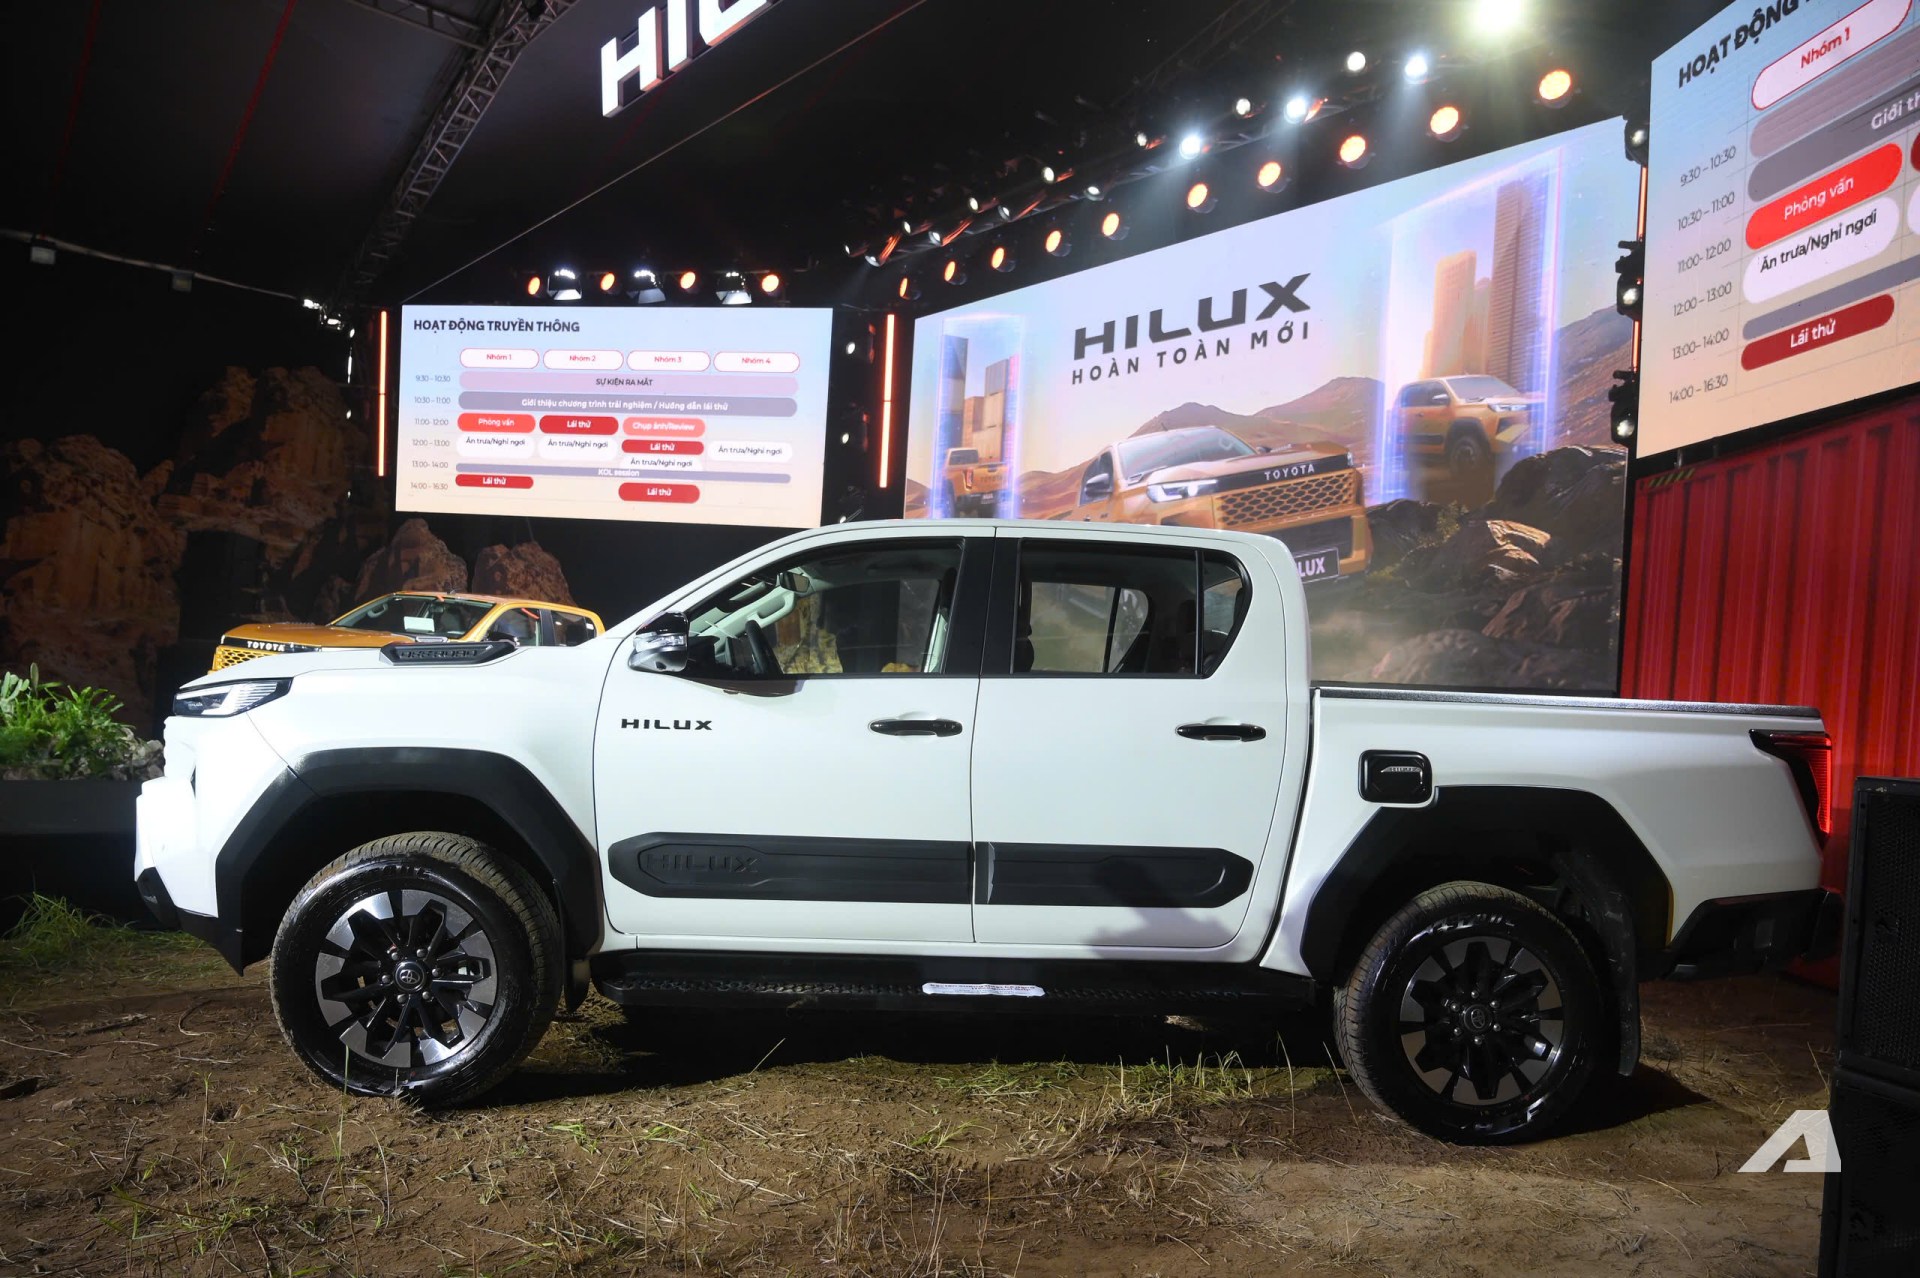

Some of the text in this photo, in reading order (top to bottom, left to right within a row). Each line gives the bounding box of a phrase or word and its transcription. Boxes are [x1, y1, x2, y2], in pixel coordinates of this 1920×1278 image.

[1678, 33, 1731, 88] HOẠT
[1801, 27, 1850, 69] Nhóm 1
[1871, 100, 1903, 129] Giới
[1680, 166, 1701, 187] 9:30
[1710, 145, 1737, 170] 10:30
[1829, 176, 1854, 197] vấn
[1678, 209, 1702, 231] 10:30
[1711, 192, 1735, 213] 11:00
[1706, 238, 1731, 259] 12:00
[1760, 255, 1777, 273] Ăn
[1845, 209, 1877, 236] ngơi
[1673, 296, 1697, 317] 12:00
[1707, 281, 1732, 302] 13:00
[413, 317, 580, 334] HOẠT ĐỘNG TRUYỀN THÔNG
[1073, 273, 1311, 360] HILUX
[1703, 328, 1729, 348] 14:00
[1790, 318, 1836, 348] Lái thử
[1072, 320, 1309, 385] HOÀN TOÀN MỚI
[1669, 384, 1693, 403] 14:00
[1703, 373, 1729, 393] 16:30
[1264, 463, 1315, 481] TOYOTA
[246, 640, 285, 652] TOYOTA
[621, 718, 712, 730] HILUX
[647, 854, 759, 873] HILUX
